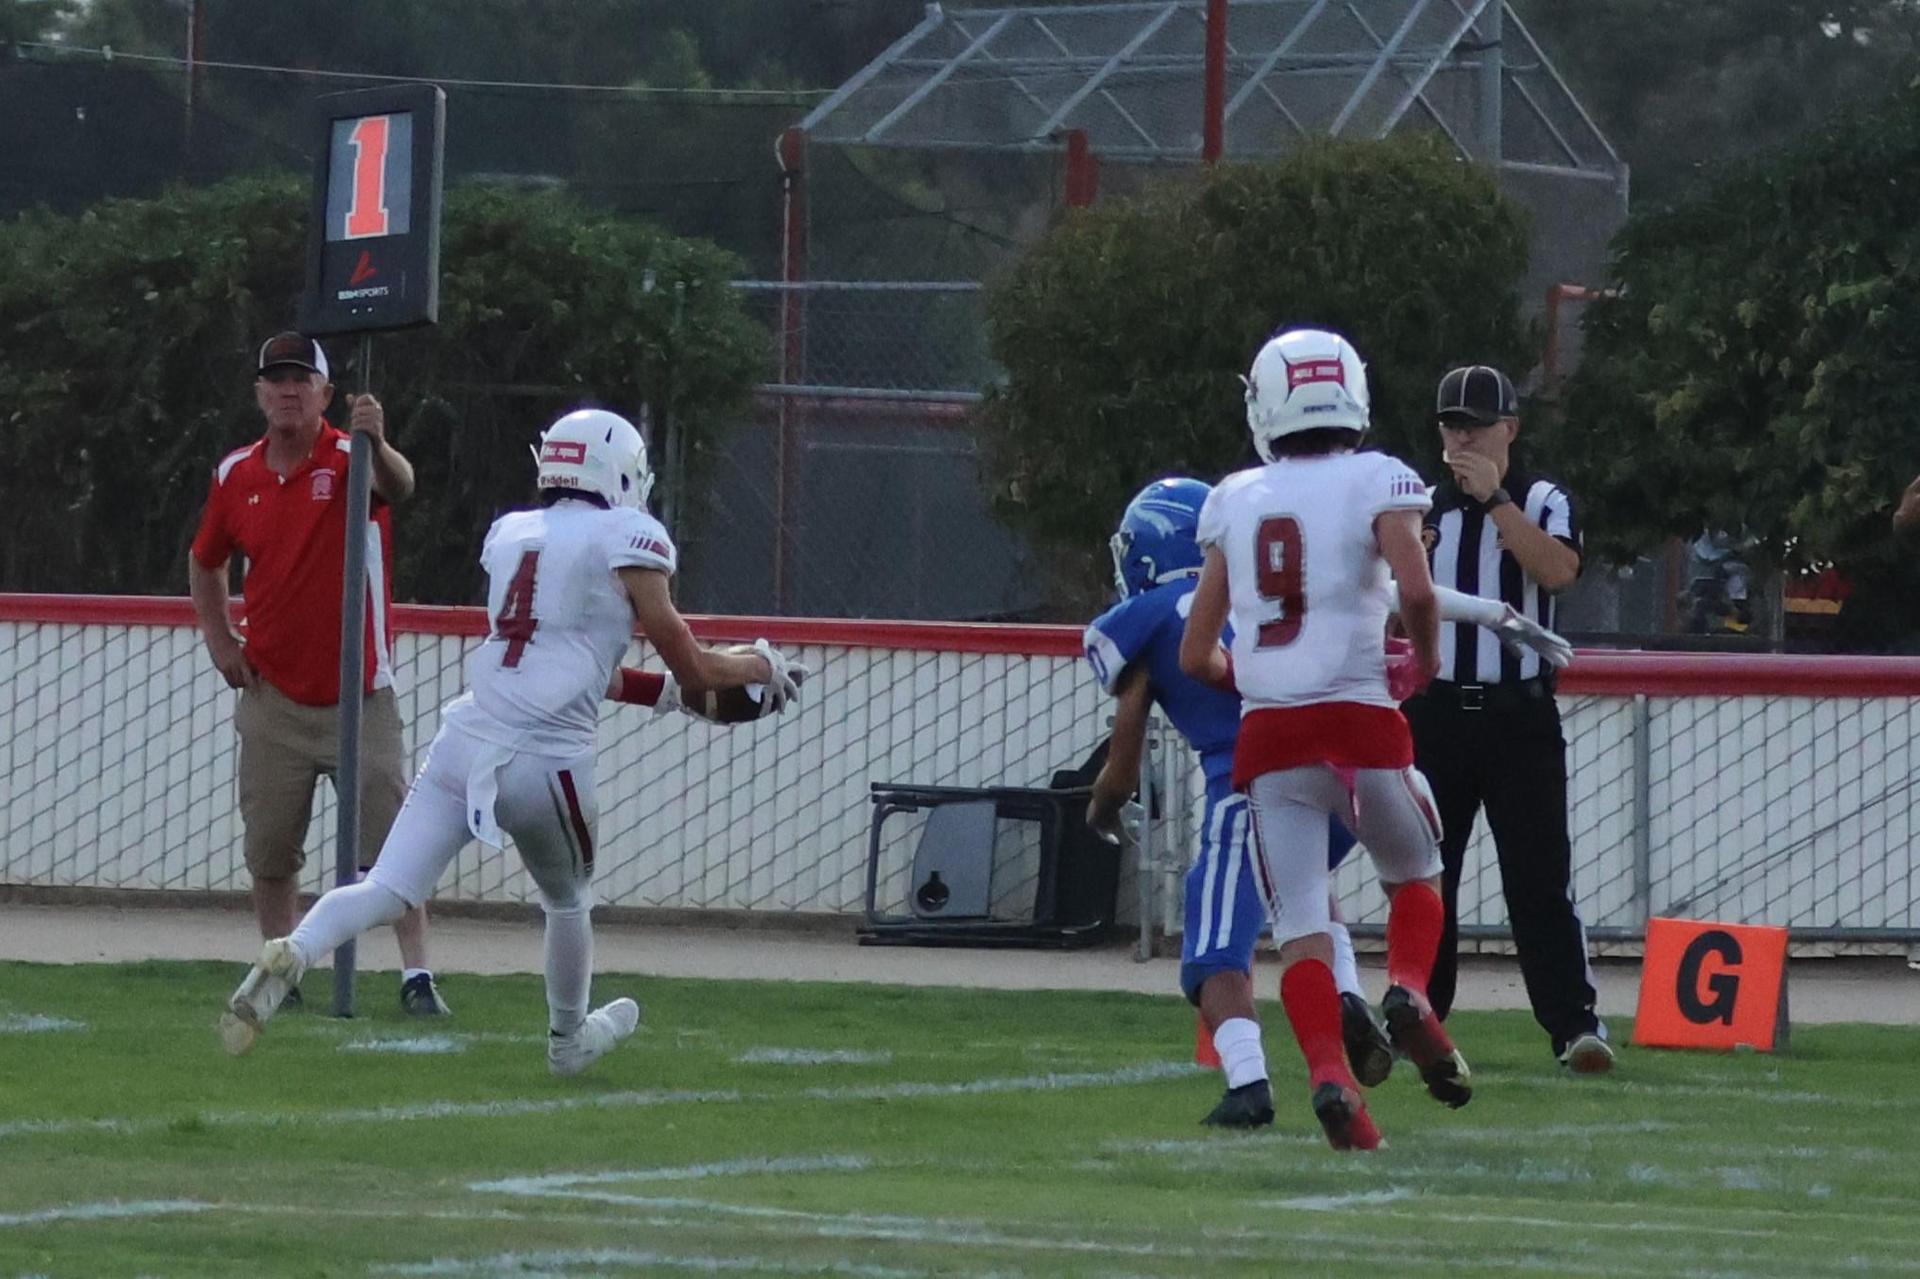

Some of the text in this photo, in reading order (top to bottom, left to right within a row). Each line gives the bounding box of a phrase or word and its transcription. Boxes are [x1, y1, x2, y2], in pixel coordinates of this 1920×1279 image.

[344, 115, 390, 240] 1
[494, 548, 542, 670] 4
[1255, 514, 1306, 652] 9
[1676, 929, 1744, 1027] G
